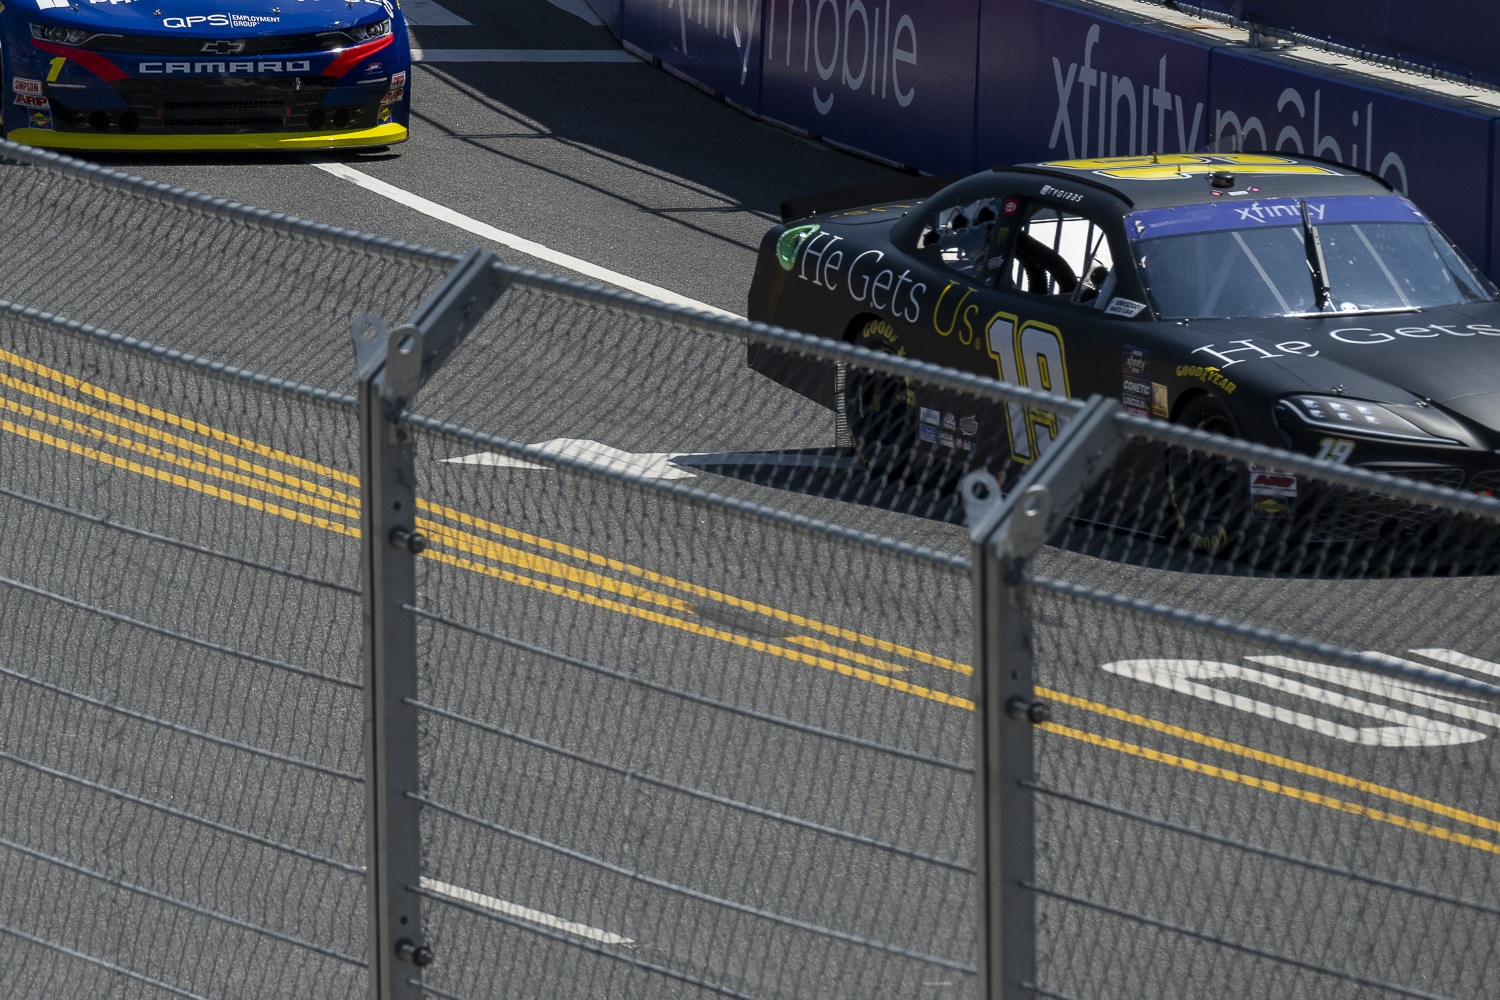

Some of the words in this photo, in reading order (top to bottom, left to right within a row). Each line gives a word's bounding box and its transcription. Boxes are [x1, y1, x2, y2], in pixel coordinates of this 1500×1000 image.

[162, 13, 229, 29] QPS
[232, 14, 281, 24] EMPLOYMENT
[232, 20, 257, 28] GROUP
[46, 56, 67, 82] 1
[139, 60, 310, 73] CAMARO
[14, 79, 39, 93] SIMPSON
[15, 93, 48, 106] ARP
[1234, 202, 1326, 224] xfinity
[798, 230, 844, 291] He
[847, 249, 928, 324] Gets
[1191, 338, 1320, 369] He
[1329, 323, 1500, 345] Gets
[1126, 355, 1145, 372] xfinity
[985, 310, 1071, 465] 19
[1123, 380, 1151, 396] COMETIC
[1176, 365, 1237, 395] GOODYEAR
[1316, 437, 1357, 465] 19
